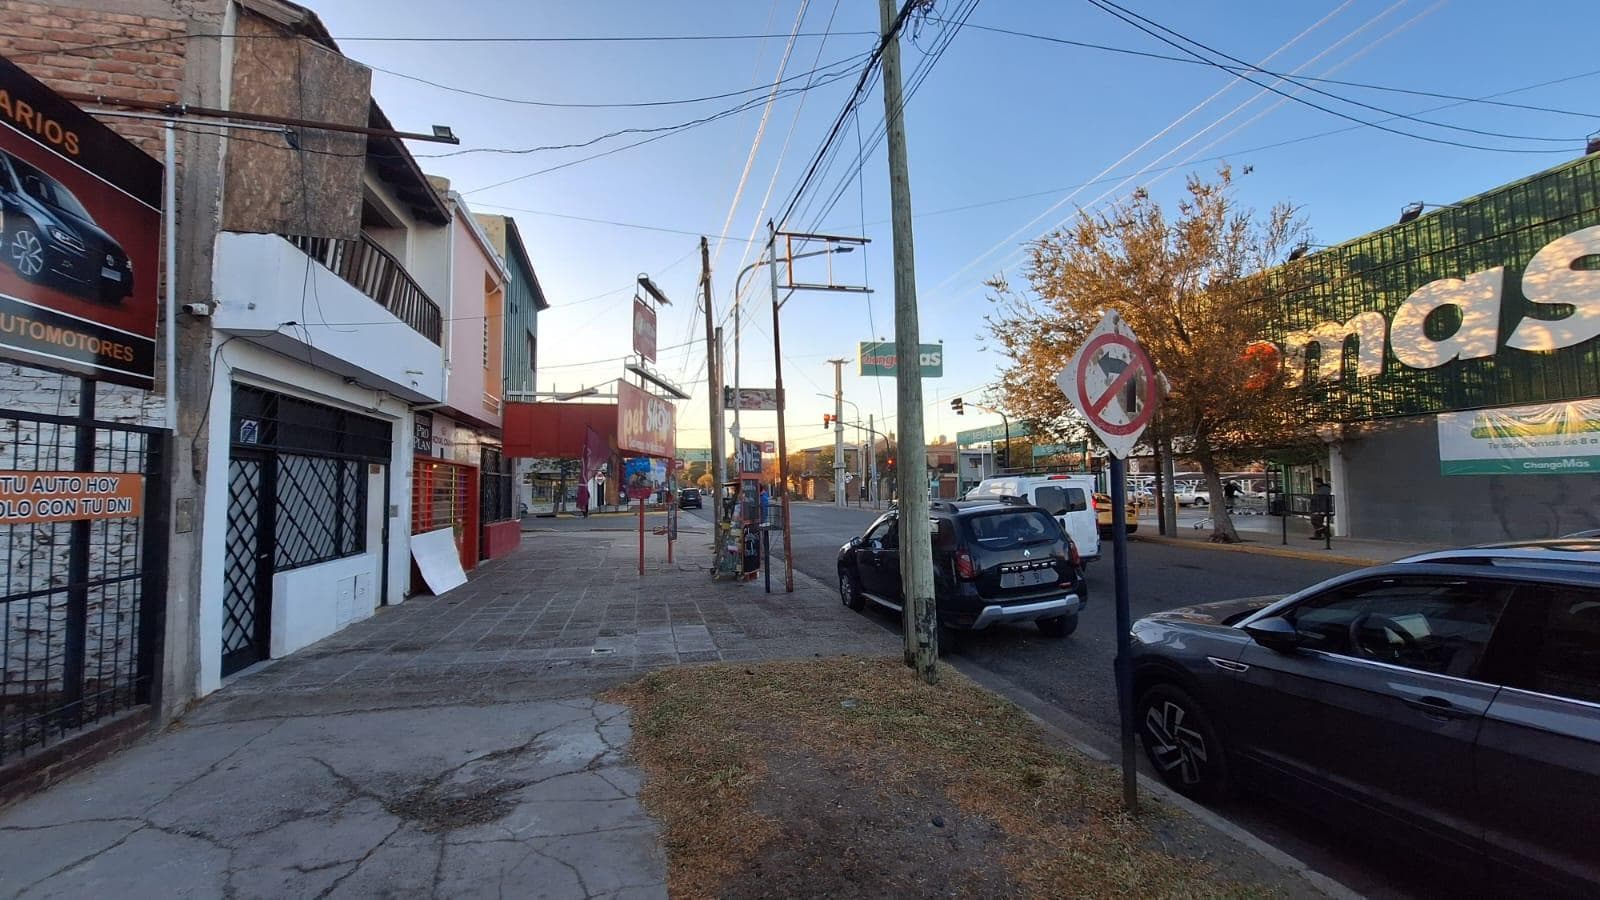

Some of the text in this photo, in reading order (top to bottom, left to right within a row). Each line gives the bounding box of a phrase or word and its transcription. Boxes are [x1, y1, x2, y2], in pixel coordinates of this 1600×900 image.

[0, 475, 119, 494] TU AUTO HOY
[37, 499, 77, 516] CON
[81, 498, 103, 515] TU
[106, 497, 132, 513] DNI
